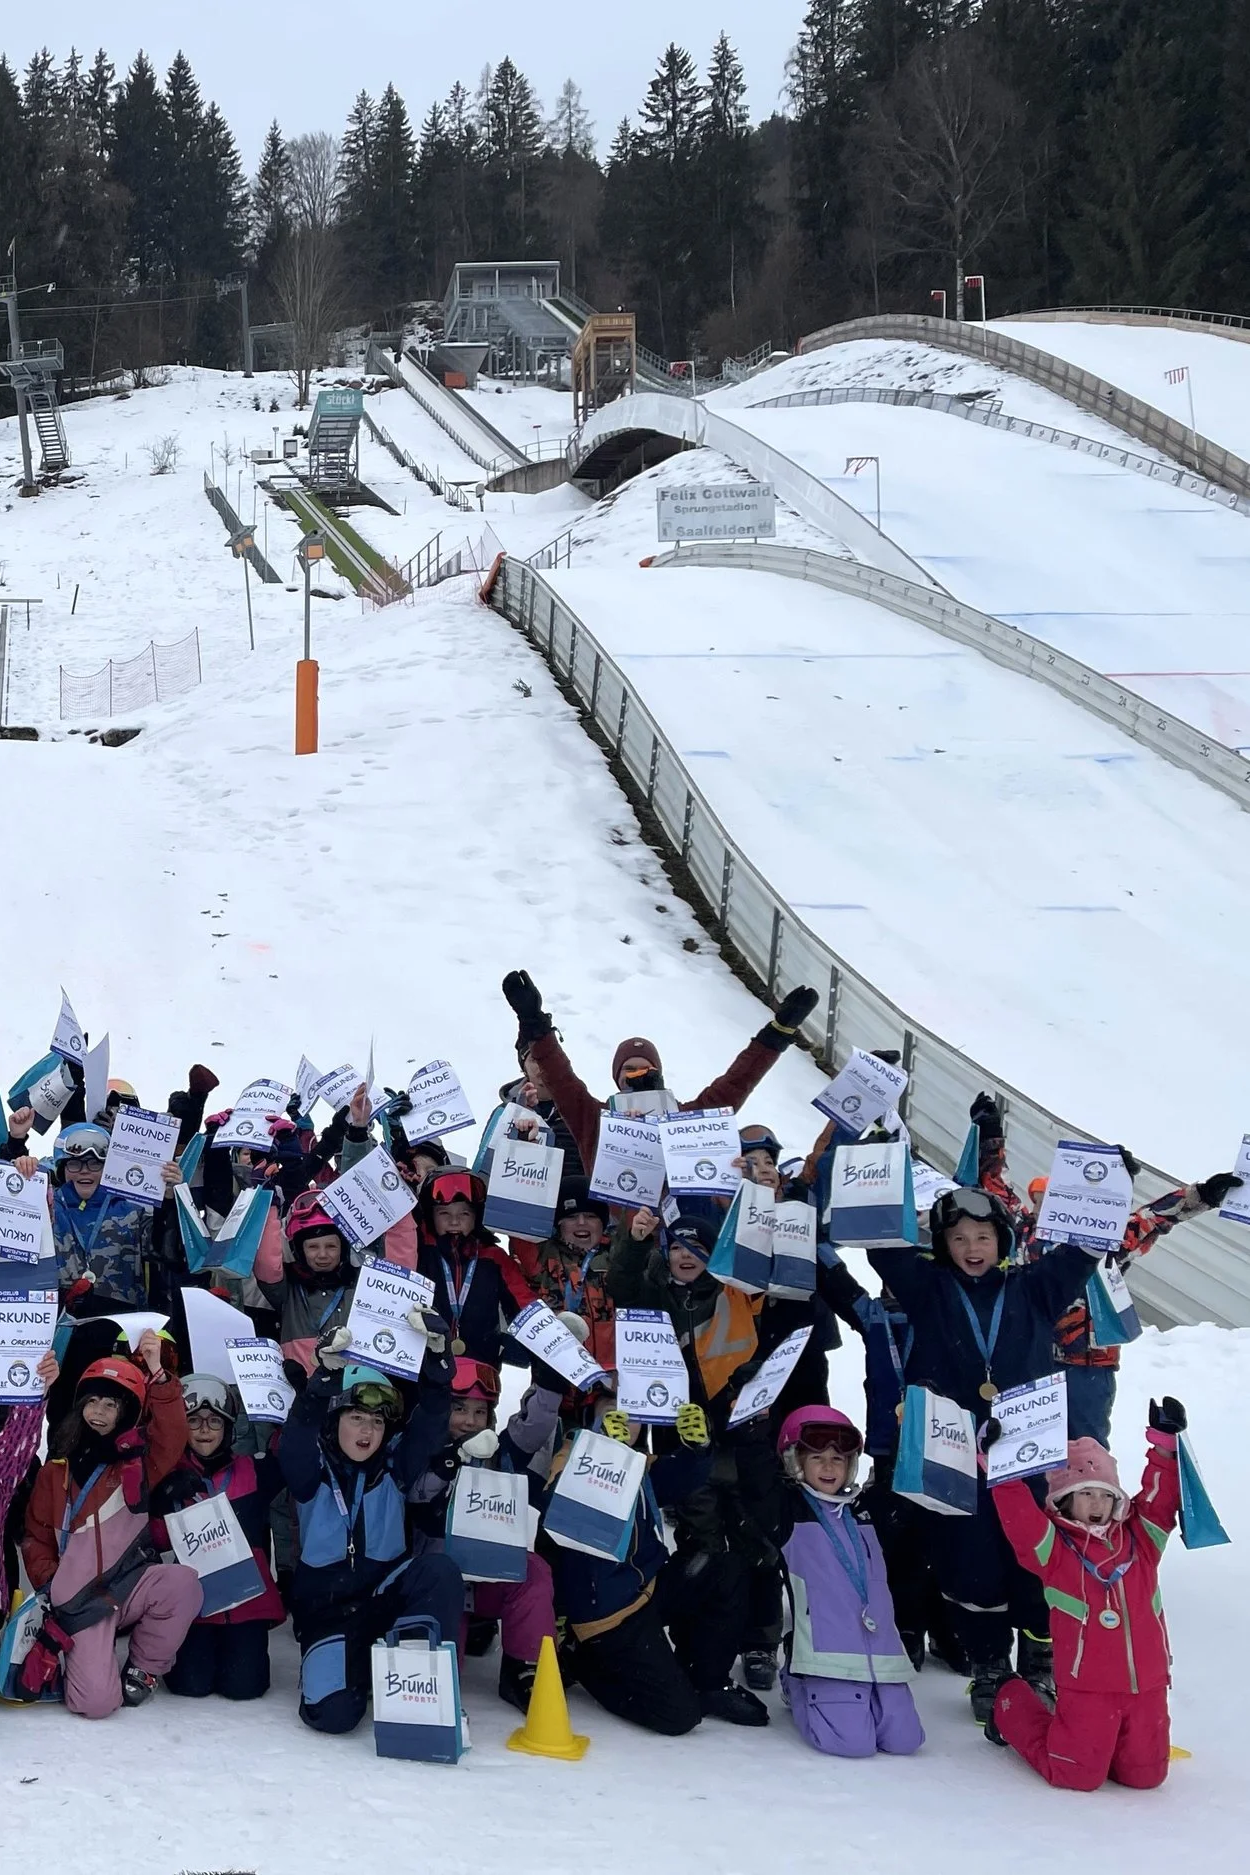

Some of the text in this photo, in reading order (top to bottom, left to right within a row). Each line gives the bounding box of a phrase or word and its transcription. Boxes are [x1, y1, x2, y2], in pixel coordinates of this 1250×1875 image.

[660, 486, 771, 501] Felix Gottwald
[674, 503, 758, 515] Sprungstadion
[676, 525, 756, 537] Saalfelden
[858, 1051, 902, 1087] URKUNDE
[323, 1072, 358, 1096] URKUNDE
[407, 1071, 451, 1094] RKUNDE
[120, 1122, 172, 1143] URKUNDE
[667, 1122, 730, 1136] URKUNDE
[515, 1177, 546, 1188] SPORTS
[856, 1179, 890, 1188] SPORTS
[333, 1186, 375, 1236] URKUNDE
[1047, 1211, 1118, 1231] URKUNDE
[366, 1277, 428, 1305] URKUNDE
[998, 1391, 1059, 1420] URKUNDE
[587, 1476, 620, 1495] SPORTS
[480, 1512, 515, 1525] SPORTS
[201, 1537, 233, 1554] SPORTS
[402, 1693, 438, 1704] SPORTS
